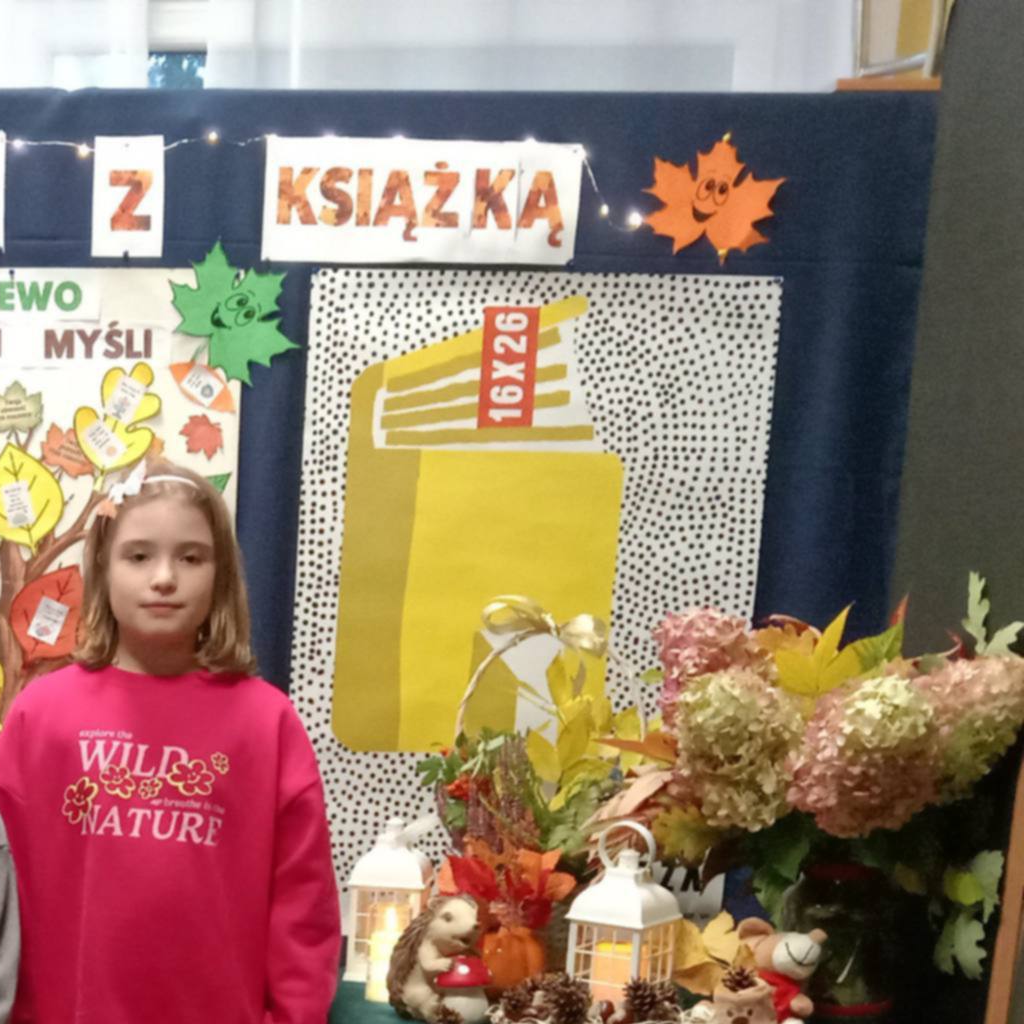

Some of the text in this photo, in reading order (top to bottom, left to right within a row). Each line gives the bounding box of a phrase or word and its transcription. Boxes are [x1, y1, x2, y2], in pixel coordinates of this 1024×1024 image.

[109, 169, 154, 232] Z
[276, 160, 565, 248] KSIĄŻKĄ
[43, 320, 153, 360] MYŚLI
[487, 311, 530, 423] 16X26
[78, 740, 189, 778] WILD
[80, 804, 223, 847] NATURE
